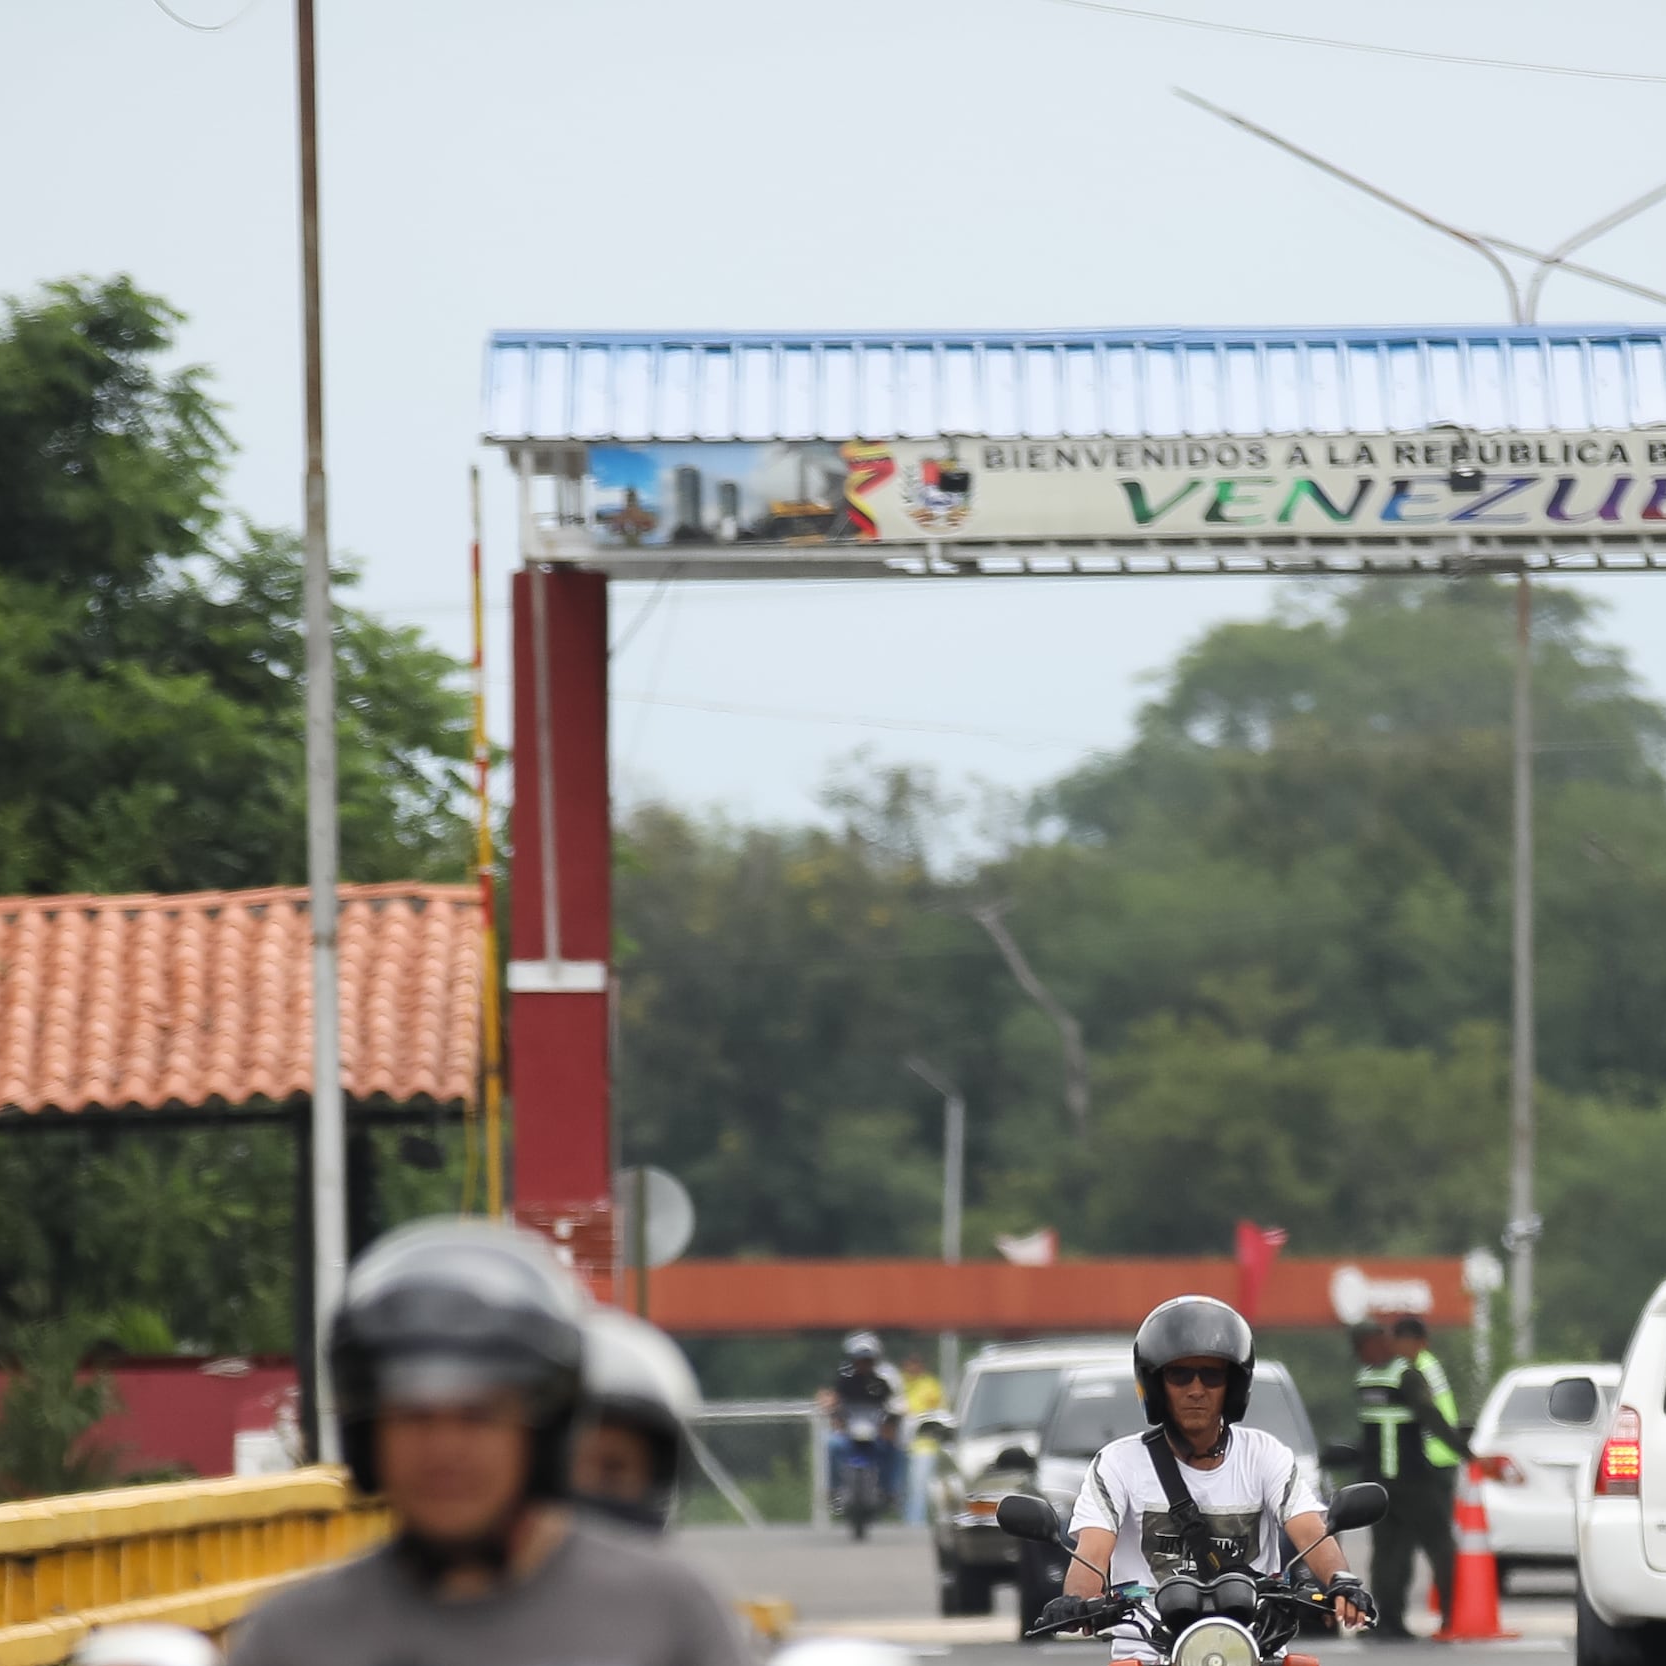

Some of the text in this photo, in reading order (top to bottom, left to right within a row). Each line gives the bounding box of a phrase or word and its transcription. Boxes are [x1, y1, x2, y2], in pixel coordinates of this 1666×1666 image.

[983, 442, 1269, 470] BIENVENIDOS
[1284, 443, 1311, 468] A
[1327, 442, 1376, 467] LA
